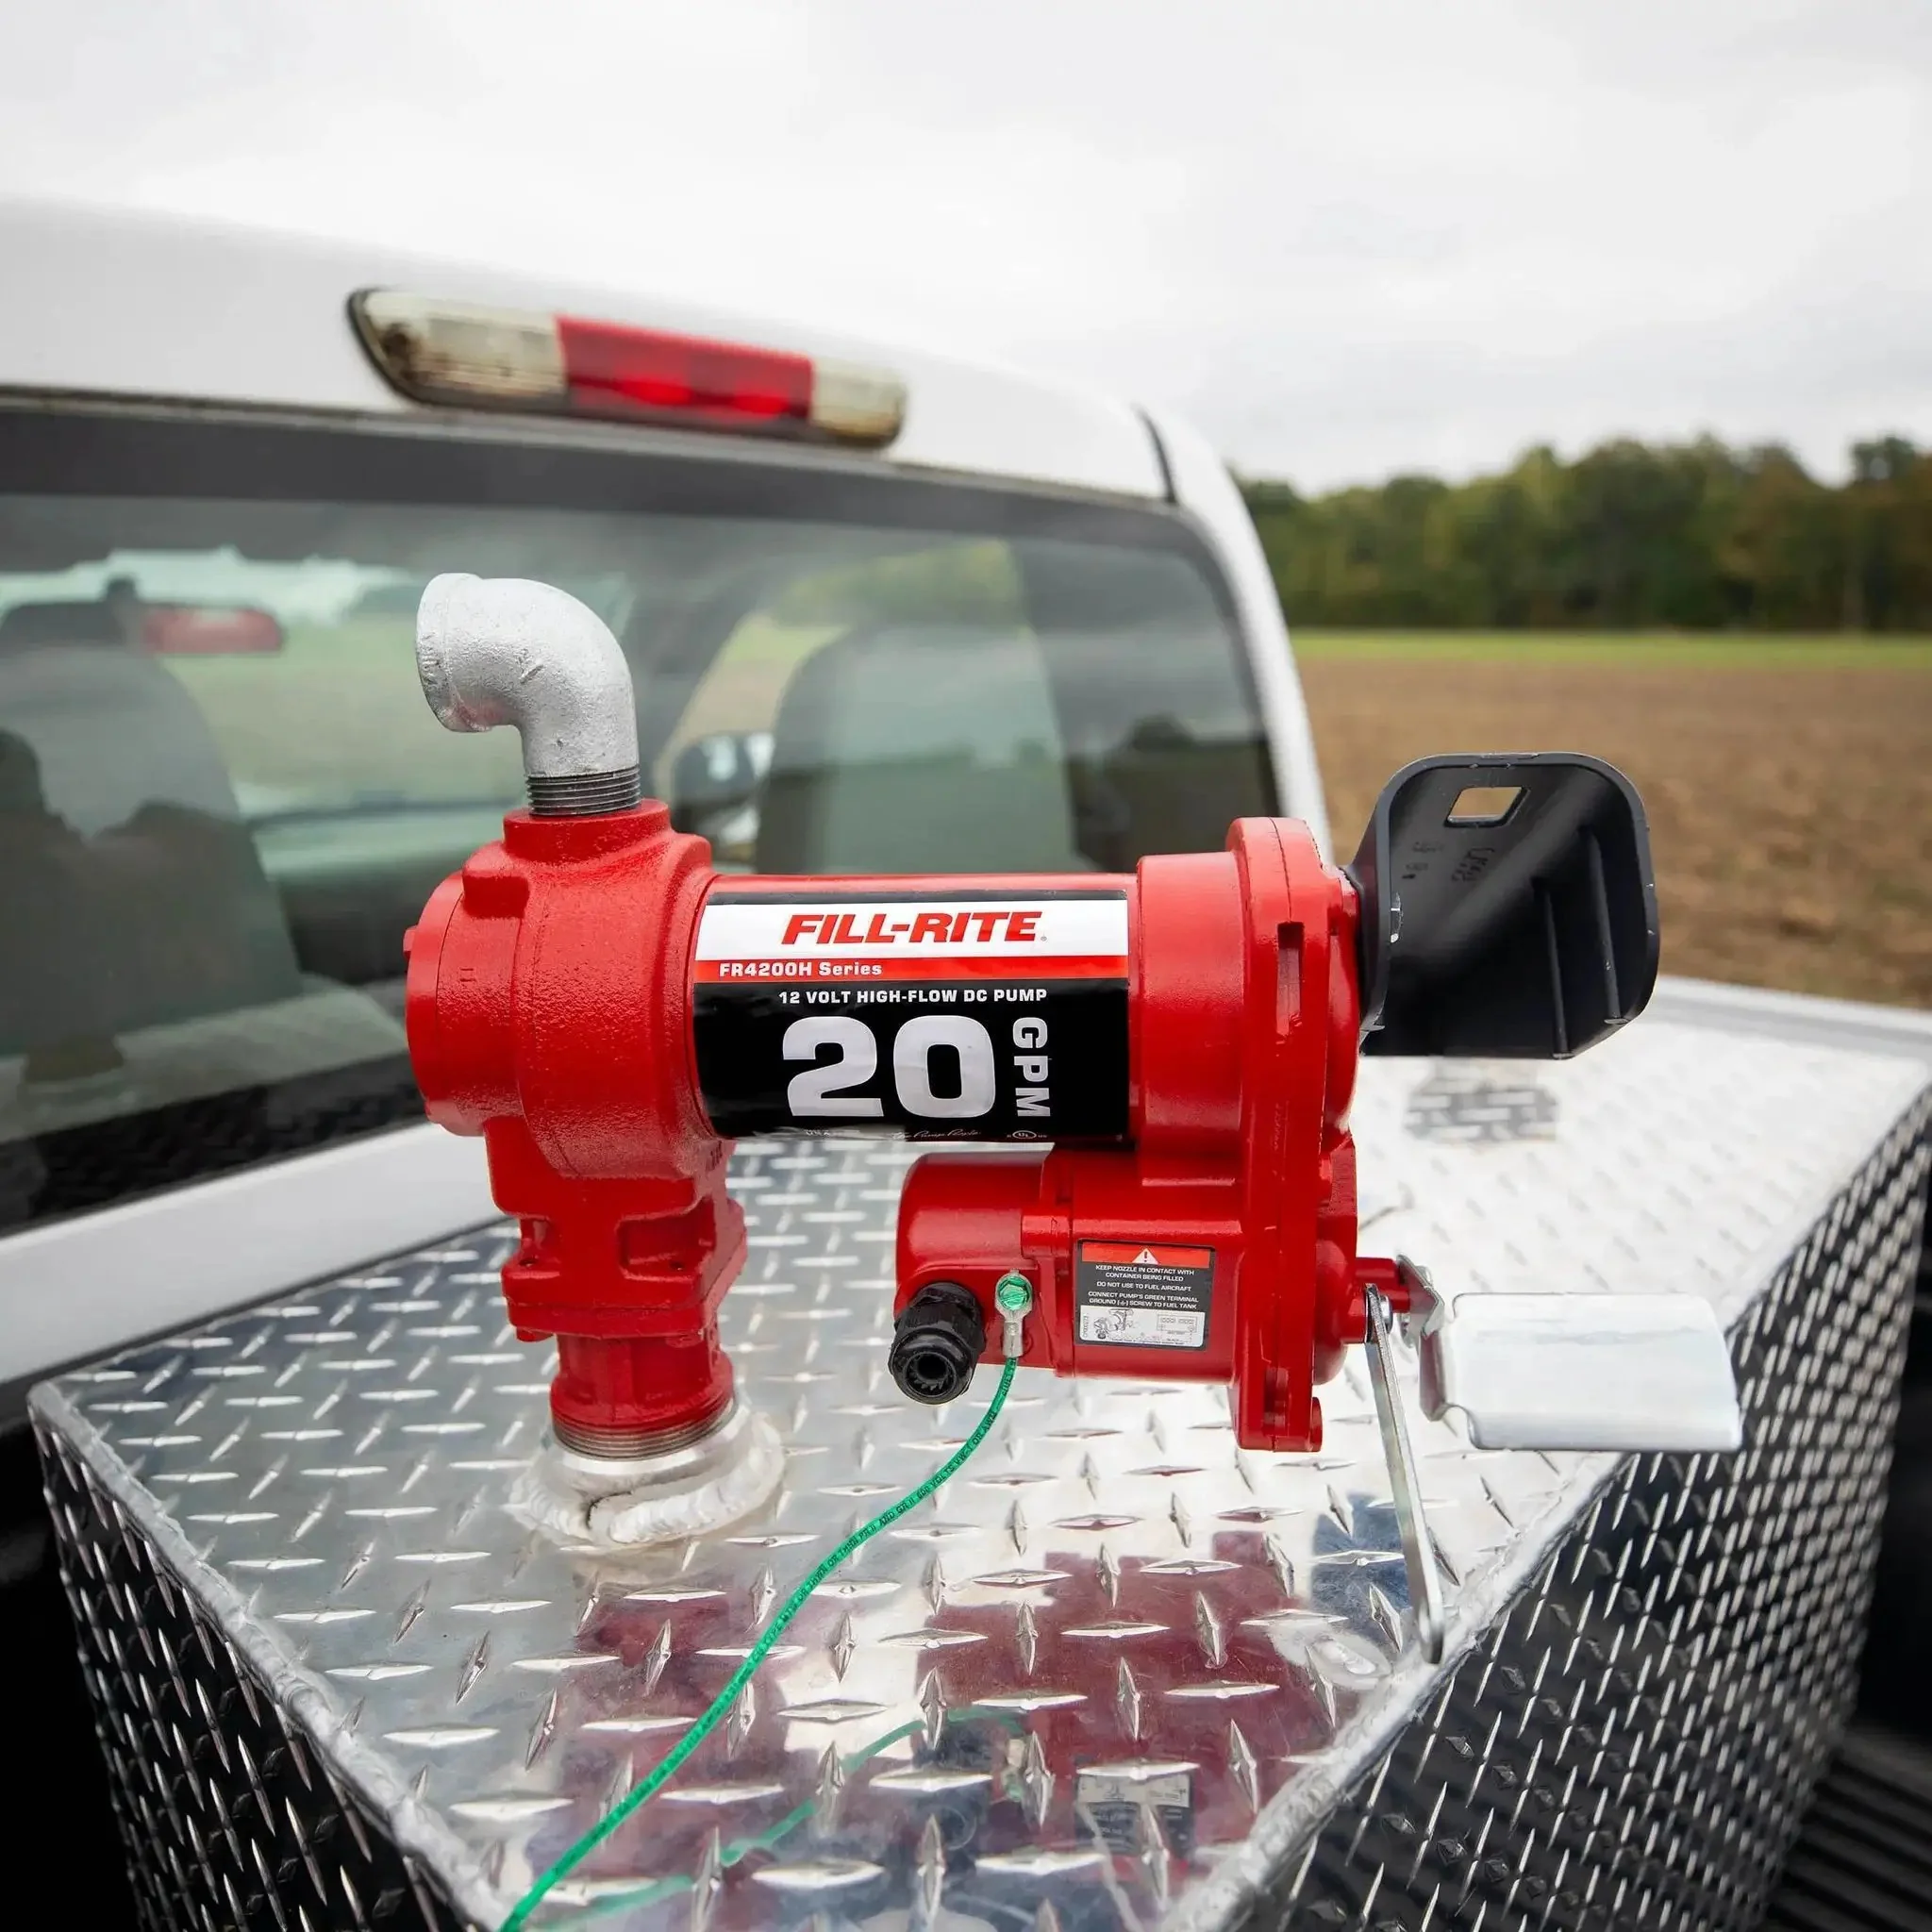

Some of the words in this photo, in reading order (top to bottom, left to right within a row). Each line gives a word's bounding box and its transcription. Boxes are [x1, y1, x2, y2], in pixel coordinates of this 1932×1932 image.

[781, 911, 1042, 945] FILL-RITE
[719, 961, 811, 978] FR4200H
[818, 961, 882, 976] Series
[779, 991, 800, 1004] 12
[806, 991, 851, 1004] VOLT
[857, 990, 957, 1004] HIGH-FLOW
[964, 989, 988, 1003] DC
[993, 989, 1047, 1002] PUMP
[782, 1015, 996, 1118] 20
[1012, 1017, 1051, 1117] GPM
[824, 1553, 840, 1568] OR
[876, 1509, 895, 1526] AND
[928, 1463, 955, 1489] VOLTS
